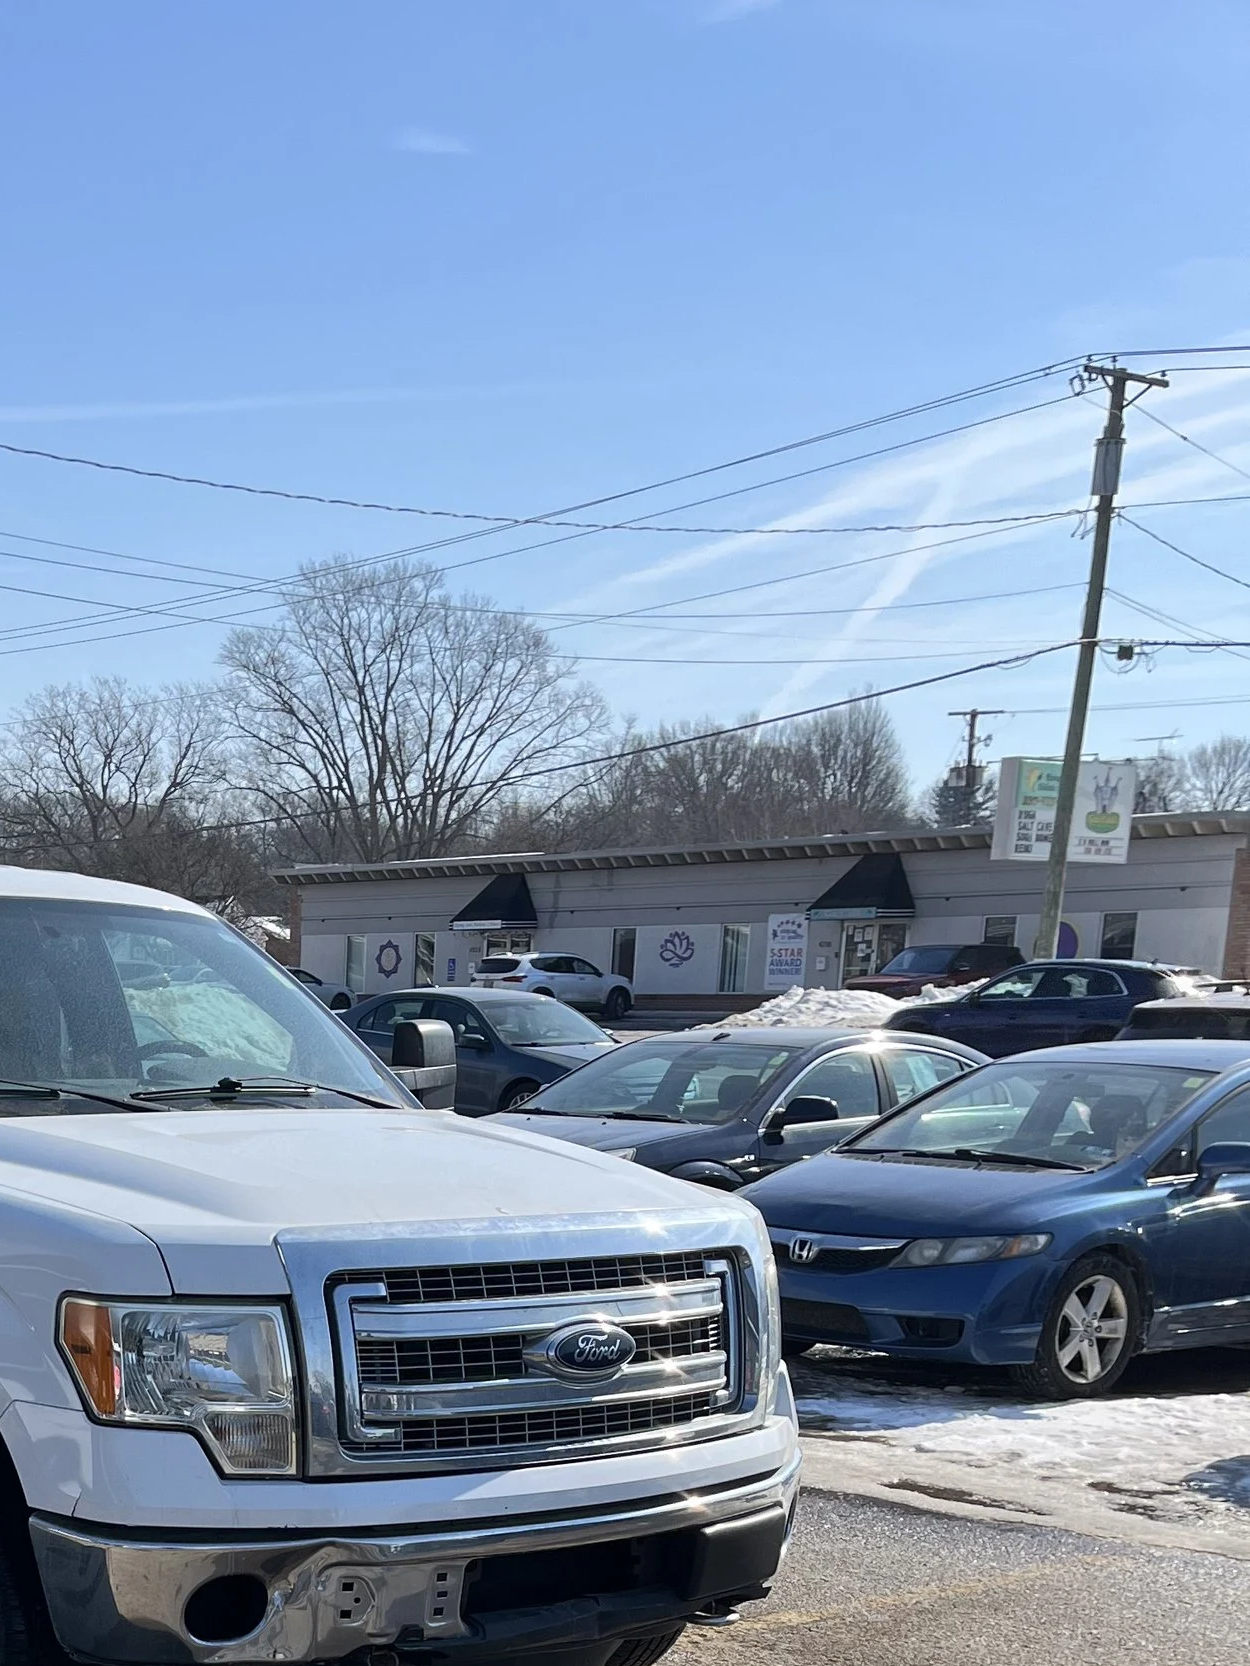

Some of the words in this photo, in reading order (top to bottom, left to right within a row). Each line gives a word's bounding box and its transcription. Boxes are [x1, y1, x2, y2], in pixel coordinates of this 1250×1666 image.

[770, 947, 803, 958] 5-STAR
[769, 958, 802, 967] AWARD
[574, 1334, 621, 1363] Ford
